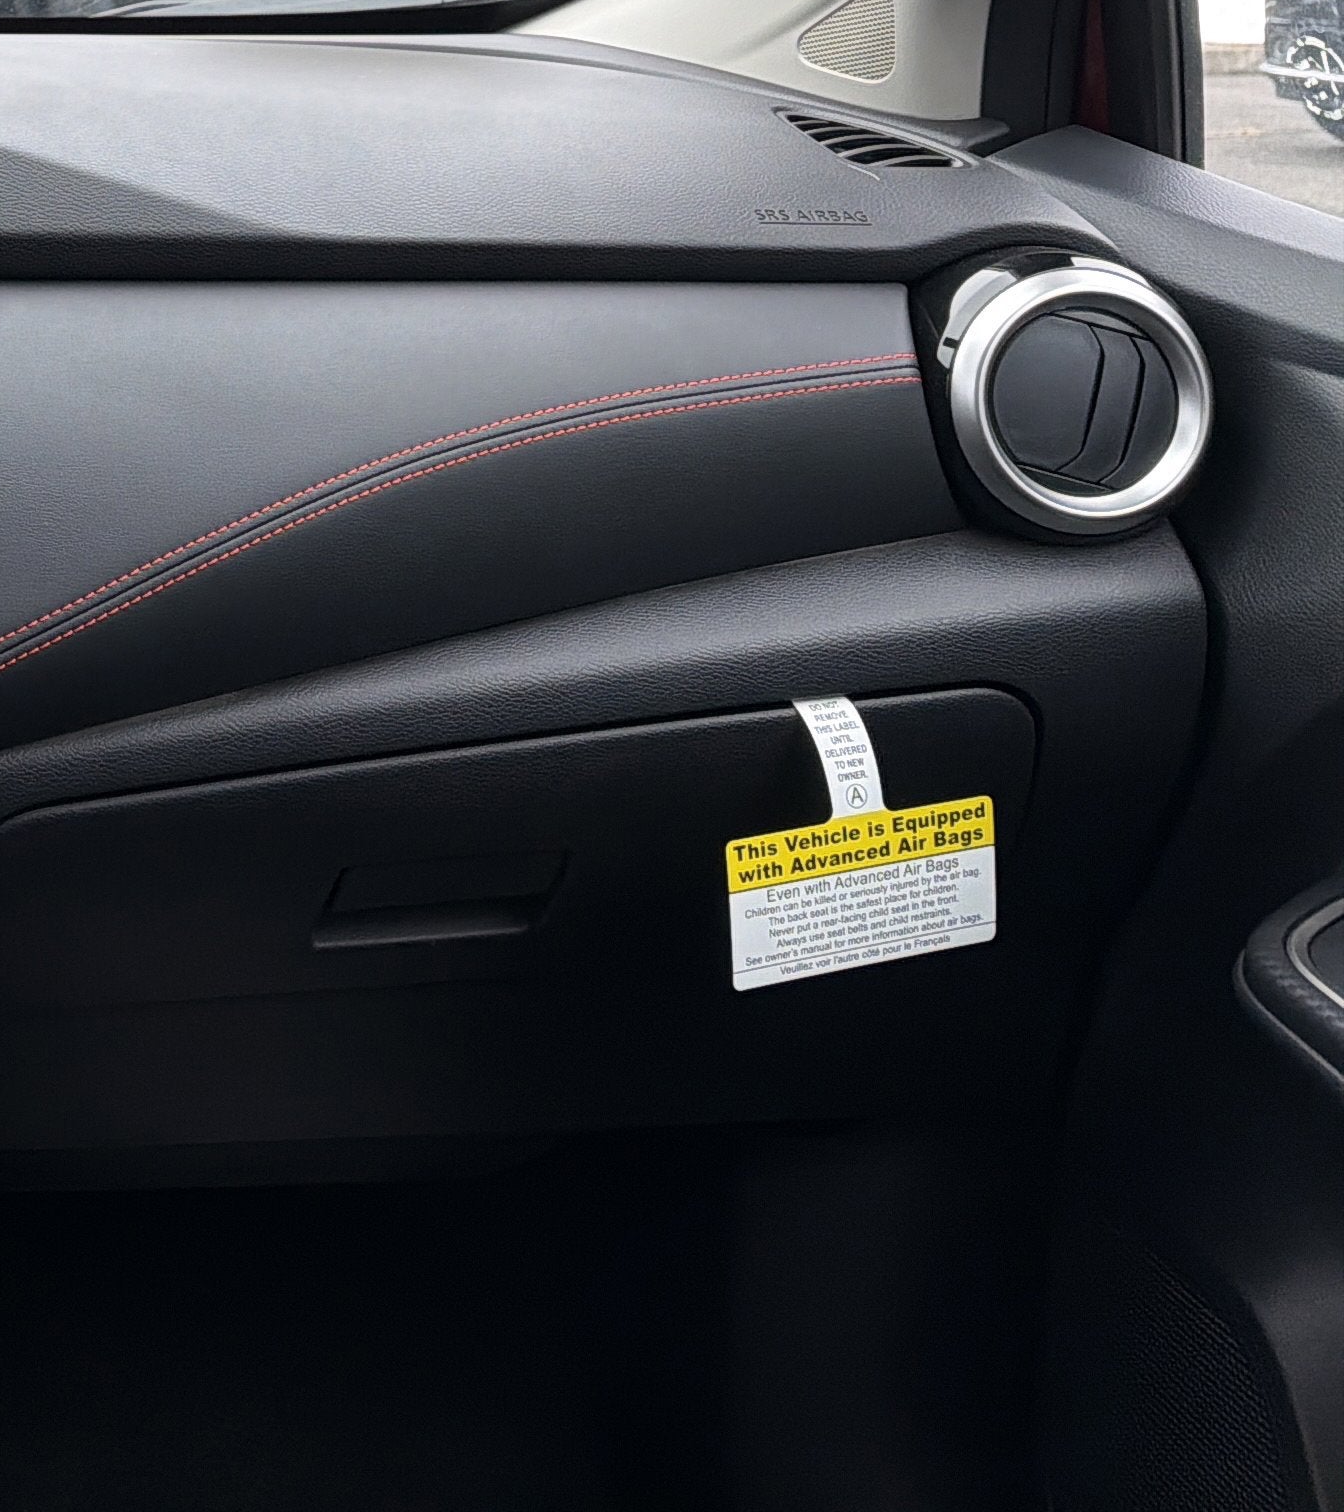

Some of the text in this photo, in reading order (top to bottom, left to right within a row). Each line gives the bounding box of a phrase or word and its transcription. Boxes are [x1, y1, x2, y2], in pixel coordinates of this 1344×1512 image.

[754, 209, 868, 222] SRS AIRBAG
[814, 710, 849, 722] REMOVE
[814, 720, 860, 734] THIS LABEL
[824, 744, 867, 758] DELIVERED
[830, 734, 854, 745] UNTIL
[835, 758, 864, 770] TO NEW
[733, 802, 986, 862] This Vehicle is Equipped
[738, 827, 984, 883] with Advanced Air Bags
[744, 867, 982, 919] Children can be killed or seriously injured by the air bag.
[766, 856, 960, 903] Even with Advanced Air Bags
[768, 915, 785, 927] The
[787, 910, 808, 924] back
[809, 905, 829, 918] seat
[840, 901, 854, 913] the
[856, 895, 882, 910] safest
[884, 892, 907, 907] place
[909, 889, 921, 900] for
[768, 926, 795, 939] Never
[797, 923, 811, 937] put
[820, 912, 867, 929] rear-facing
[868, 906, 889, 919] child
[890, 902, 910, 915] seat
[921, 897, 935, 908] the
[745, 917, 959, 967] See owner's manual for more information about air
[776, 934, 807, 950] Always
[809, 932, 825, 943] use
[827, 926, 846, 939] seat
[847, 922, 869, 935] belts
[870, 919, 887, 932] and
[888, 914, 909, 927] child
[780, 933, 951, 976] Veuillez voir l'autre pour Français
